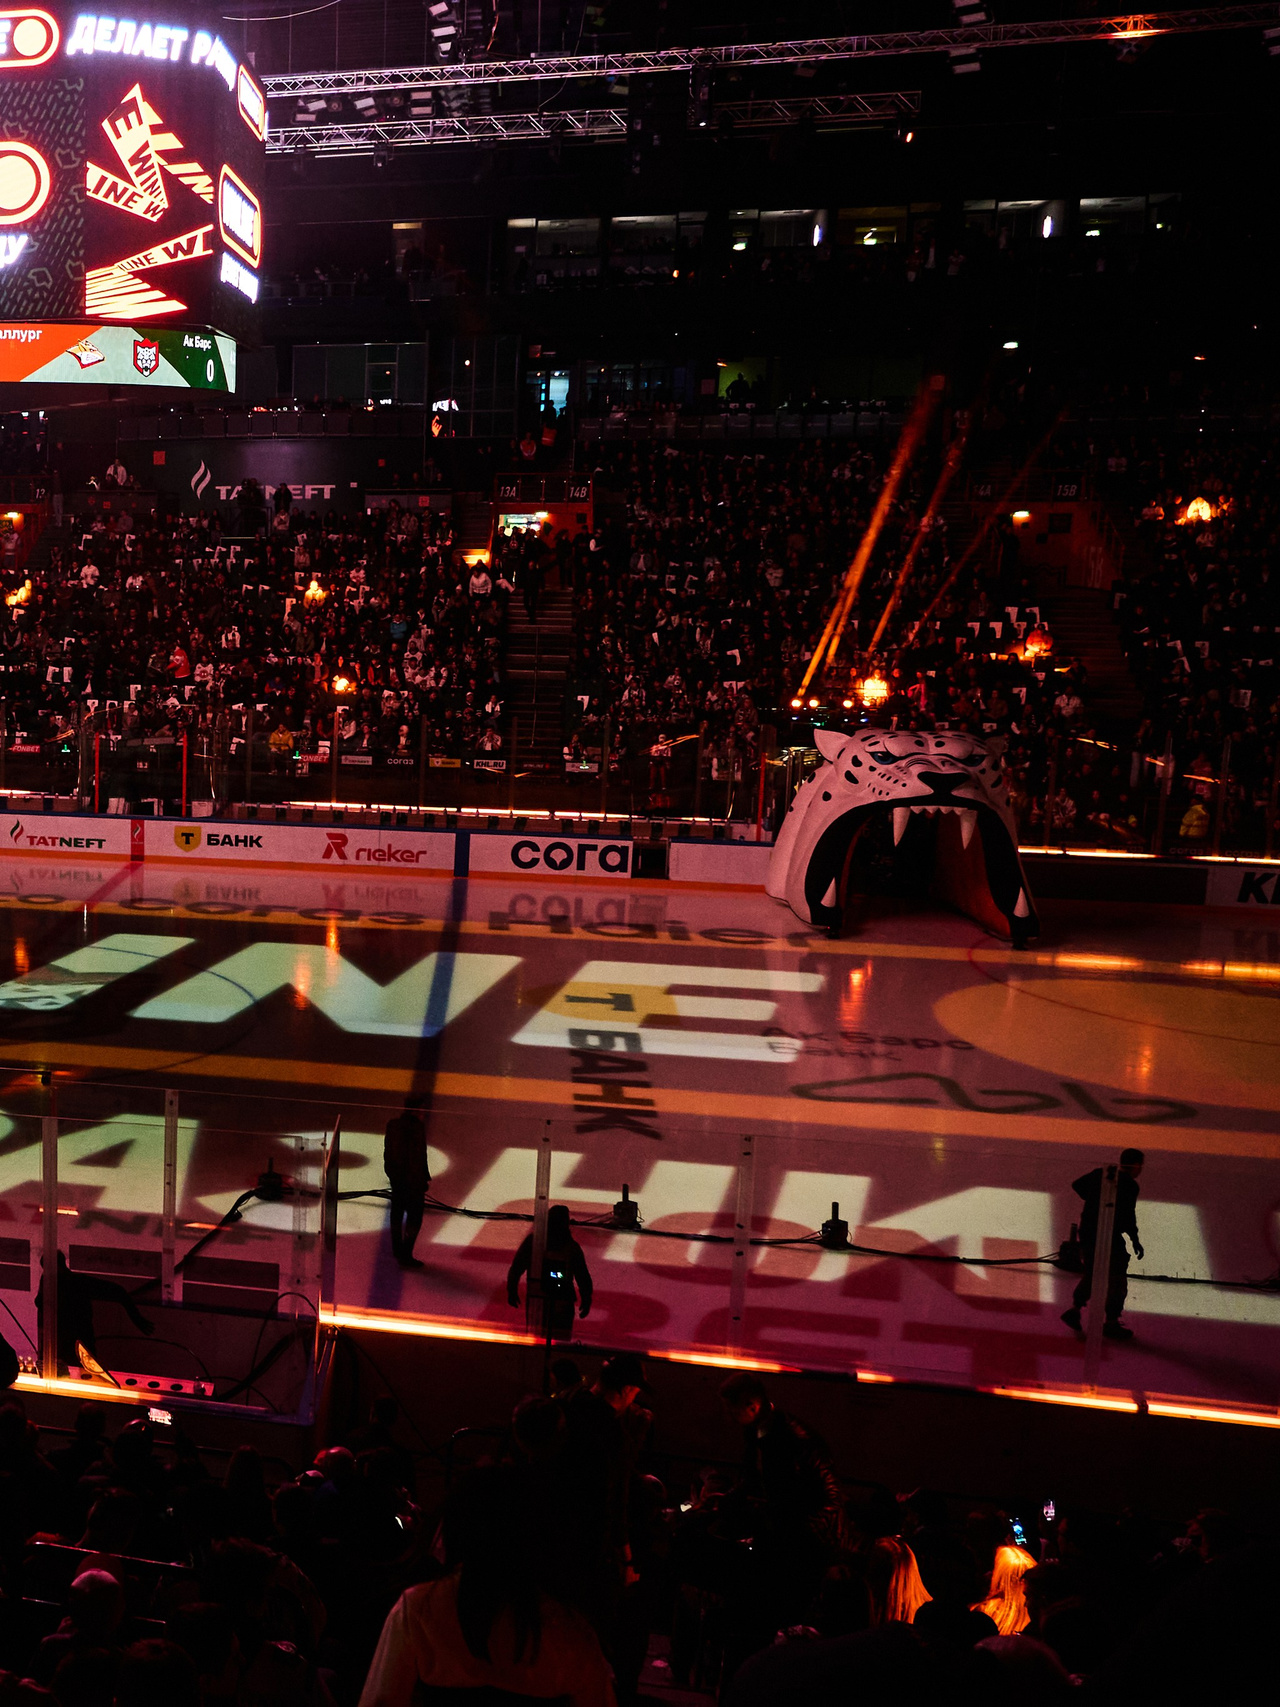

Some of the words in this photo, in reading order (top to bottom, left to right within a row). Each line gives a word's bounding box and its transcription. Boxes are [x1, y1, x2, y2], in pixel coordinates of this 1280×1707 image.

[67, 15, 189, 61] ДЕЛАЕТ
[183, 335, 194, 346] Ак
[194, 336, 211, 350] Барс
[206, 359, 215, 382] 0
[215, 485, 336, 500] TANEFT
[500, 486, 517, 498] 13A
[569, 486, 587, 498] 14B
[1056, 484, 1078, 497] 15B
[387, 757, 414, 765] согаз
[475, 760, 505, 769] KHL.RU
[27, 835, 107, 849] TATNEFT
[207, 833, 263, 848] БАНК
[356, 844, 427, 863] rieker
